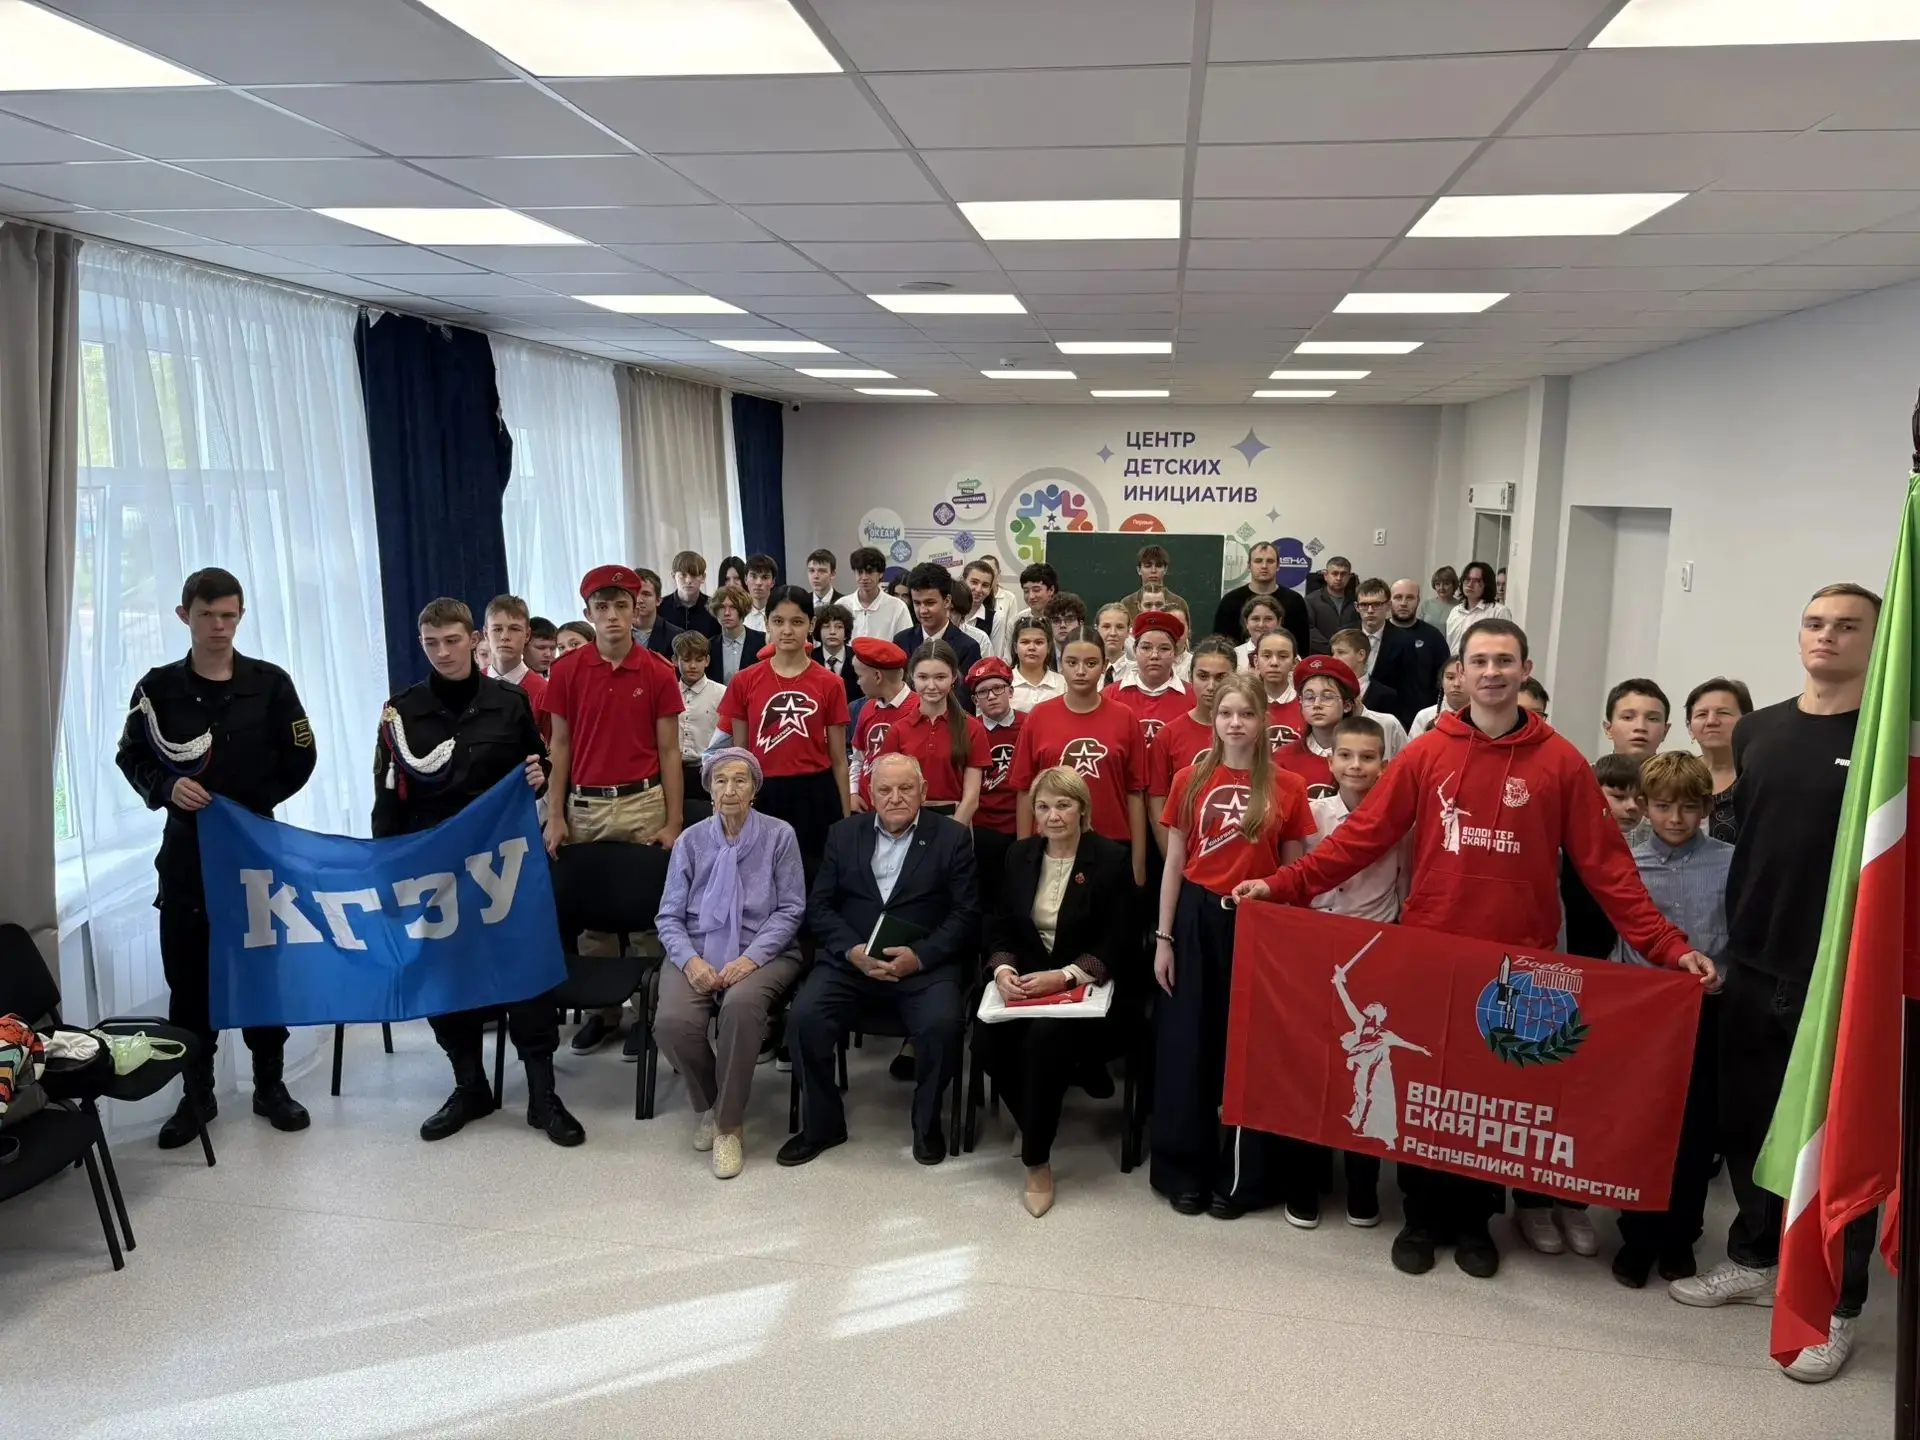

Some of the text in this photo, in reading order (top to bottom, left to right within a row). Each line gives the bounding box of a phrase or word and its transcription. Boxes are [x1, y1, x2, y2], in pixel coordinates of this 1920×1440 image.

[1126, 431, 1196, 450] ЦЕНТР
[1124, 458, 1221, 477] ДЕТСКИХ
[1124, 485, 1258, 504] ИНИЦИАТИВ
[240, 837, 529, 950] КГЭУ
[1513, 955, 1584, 975] Боевое
[1406, 1081, 1554, 1126] ВОЛОНТЕР
[1530, 1166, 1640, 1202] ТАТАРСТАН
